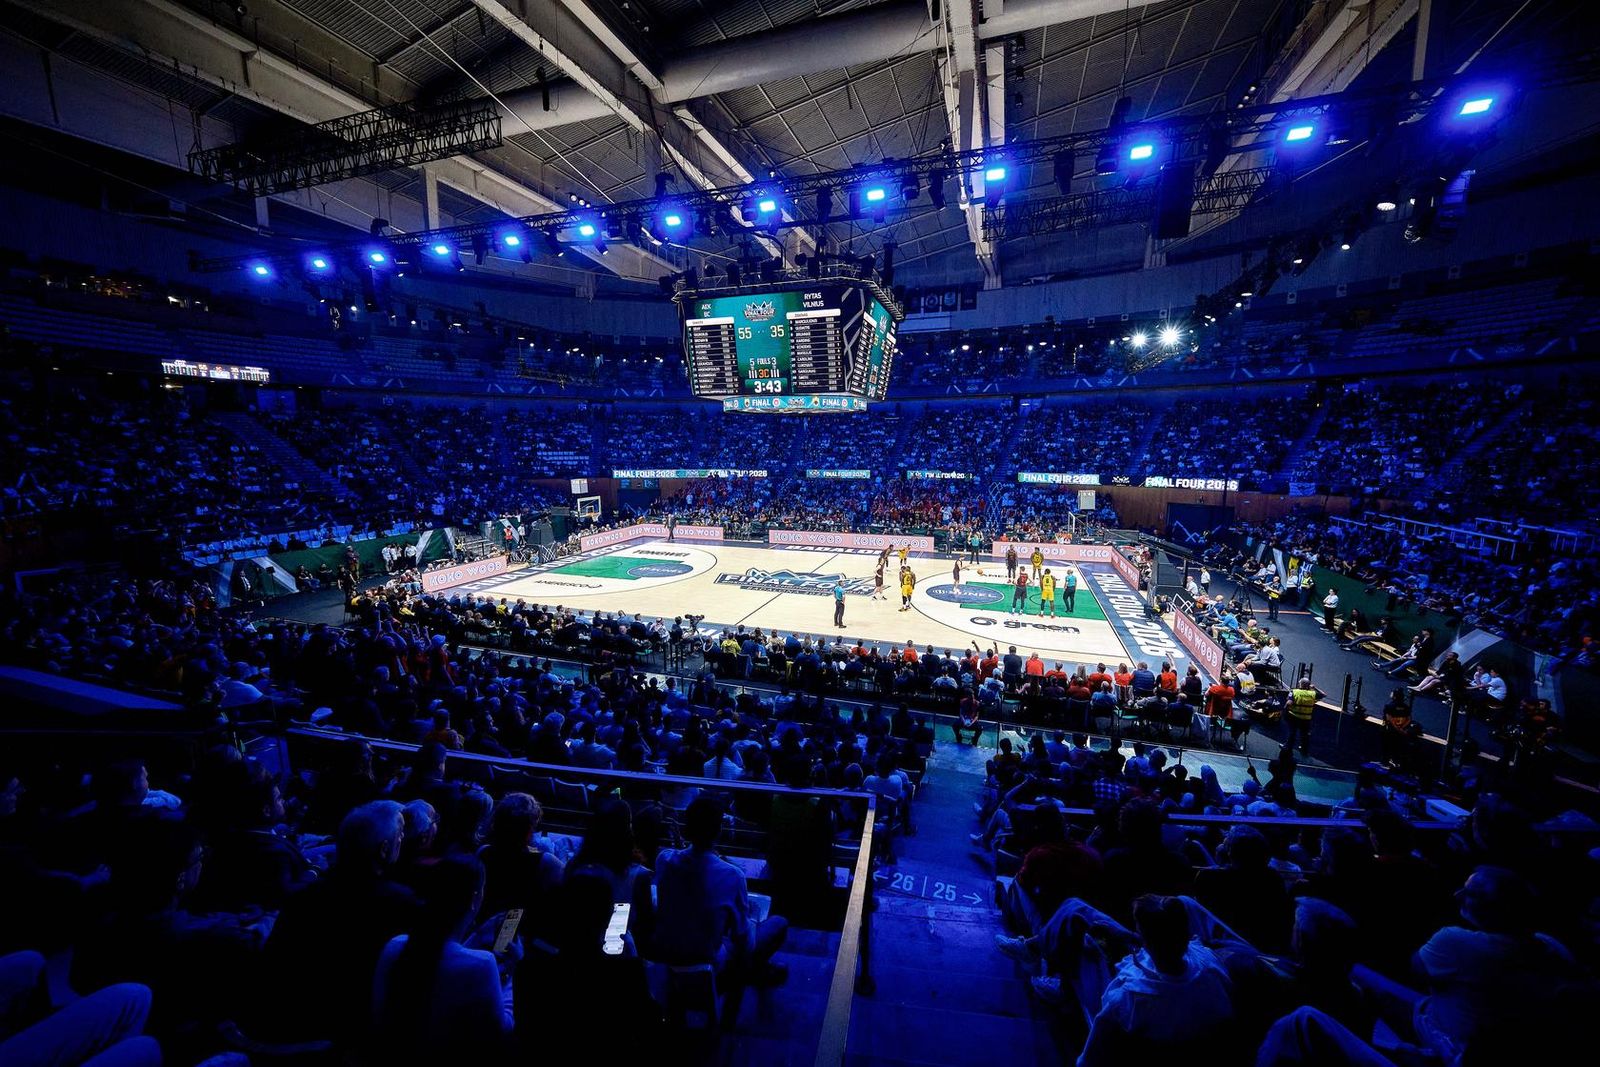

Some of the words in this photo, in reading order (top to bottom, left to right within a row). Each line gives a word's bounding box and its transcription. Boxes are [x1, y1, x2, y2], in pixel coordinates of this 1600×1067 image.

[803, 300, 825, 308] VILNIUS
[738, 327, 752, 340] 55
[770, 325, 785, 338] 35
[750, 358, 755, 366] 5
[757, 357, 771, 365] FOULS
[771, 357, 777, 365] 3
[754, 380, 782, 393] 3:43
[822, 399, 841, 407] FINAL
[613, 470, 635, 478] FINAL
[635, 470, 656, 478] FOUR
[748, 470, 768, 478] 2026
[1023, 473, 1048, 483] FINAL
[1048, 474, 1072, 484] FOUR
[1145, 477, 1174, 488] FINAL
[1176, 478, 1205, 489] FOUR
[1206, 479, 1238, 491] 2026
[586, 537, 603, 546] KOKO
[604, 532, 624, 542] WOOD
[673, 528, 694, 536] KOKO
[697, 529, 721, 537] WOOD
[774, 532, 803, 542] KOKO
[807, 534, 843, 545] WOOD
[854, 536, 884, 546] KOKO
[889, 538, 929, 549] WOOD
[1000, 545, 1028, 555] KKO
[1079, 548, 1109, 558] KOKO
[429, 571, 464, 586] KOKO
[467, 560, 503, 577] WOOD
[724, 574, 797, 587] FINAL
[1003, 619, 1081, 635] green
[1122, 620, 1185, 658] 2026
[1177, 615, 1193, 642] KOKO
[1193, 633, 1218, 668] WOOD
[890, 872, 915, 891] 26
[932, 881, 957, 902] 25
